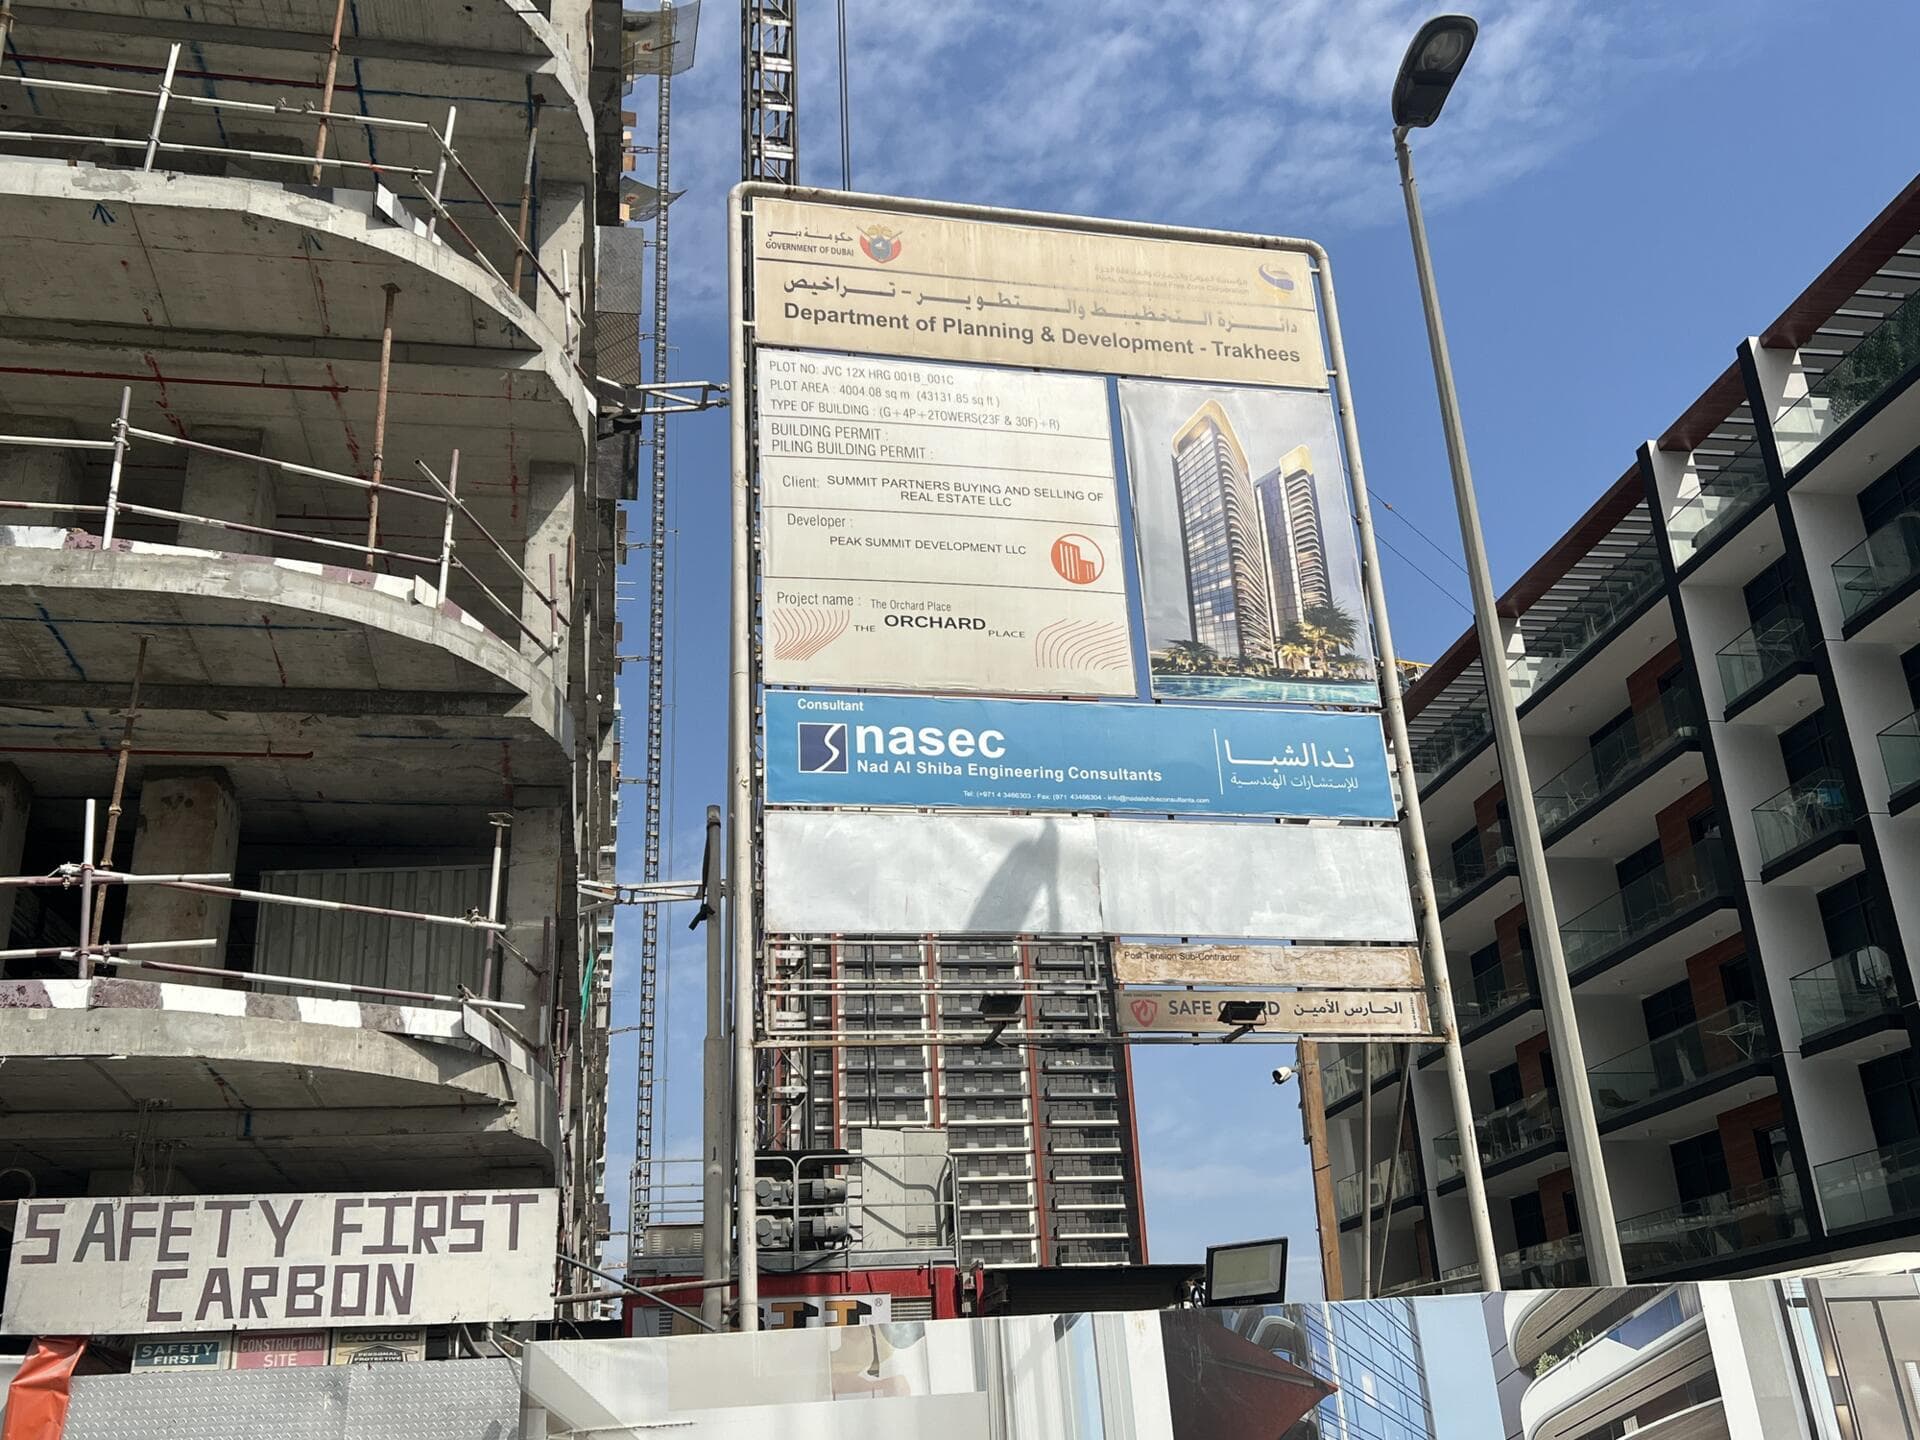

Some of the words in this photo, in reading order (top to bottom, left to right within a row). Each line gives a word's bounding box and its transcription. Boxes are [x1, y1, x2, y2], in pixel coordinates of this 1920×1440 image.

[765, 241, 817, 253] GOVERNMENT
[820, 246, 829, 254] OF
[831, 247, 854, 257] DUBAI
[784, 275, 896, 298] تراخيص
[784, 302, 910, 331] Department
[916, 317, 936, 333] of
[943, 317, 1034, 345] Planning
[1041, 326, 1055, 342] &
[1062, 327, 1194, 355] Development
[1210, 340, 1301, 363] Trakhees
[769, 360, 796, 373] PLOT
[822, 366, 842, 377] JVC
[847, 367, 866, 379] 12X
[869, 369, 891, 381] HRG
[770, 379, 797, 391] PLOT
[801, 382, 829, 394] AREA
[771, 399, 797, 411] TYPE
[801, 400, 814, 412] OF
[819, 402, 869, 416] BUILDING
[1004, 415, 1012, 426] &
[771, 423, 831, 438] BUILDING
[835, 426, 881, 441] PERMIT
[772, 440, 813, 454] PILING
[817, 442, 876, 457] BUILDING
[880, 445, 926, 459] PERMIT
[827, 475, 878, 487] SUMMIT
[882, 477, 951, 492] PARTNERS
[953, 482, 1001, 495] BUYING
[1004, 485, 1031, 497] AND
[1034, 488, 1085, 501] SELLING
[1088, 492, 1104, 502] OF
[900, 491, 934, 502] REAL
[937, 493, 986, 505] ESTATE
[989, 497, 1012, 507] LLC
[787, 513, 846, 530] Developer
[829, 536, 862, 547] PEAK
[865, 537, 912, 549] SUMMIT
[915, 539, 1002, 554] DEVELOPMENT
[1005, 545, 1027, 555] LLC
[777, 591, 819, 608] Project
[822, 594, 854, 606] name
[870, 599, 887, 610] The
[890, 599, 925, 611] Orchard
[927, 601, 952, 612] Place
[853, 624, 876, 633] THE
[884, 614, 986, 631] ORCHARD
[988, 630, 1026, 639] PLACE
[797, 698, 865, 712] Consultant
[855, 723, 1007, 760] nasec
[857, 760, 889, 774] Nad
[894, 761, 911, 774] Al
[916, 760, 963, 777] Shiba
[968, 763, 1064, 783] Engineering
[1068, 766, 1163, 782] Consultants
[1230, 771, 1287, 790] الهندسية
[1124, 950, 1143, 960] Post
[1145, 951, 1178, 962] Tension
[1179, 952, 1241, 962] Sub-Contractor
[1168, 1000, 1213, 1016] SAFE
[1293, 998, 1340, 1017] الأمين
[1344, 1001, 1403, 1017] الحارس
[21, 1199, 305, 1265] SAFETY
[331, 1193, 539, 1257] FIRST
[146, 1262, 415, 1323] CARBON
[240, 1335, 323, 1353] CONSTRUCTION
[344, 1331, 417, 1343] CAUTION
[141, 1343, 214, 1359] SAFETY
[153, 1354, 200, 1366] FIRST
[263, 1352, 297, 1368] SITE
[354, 1355, 401, 1363] PROTECTIVE
[357, 1350, 399, 1358] PERSONAL
